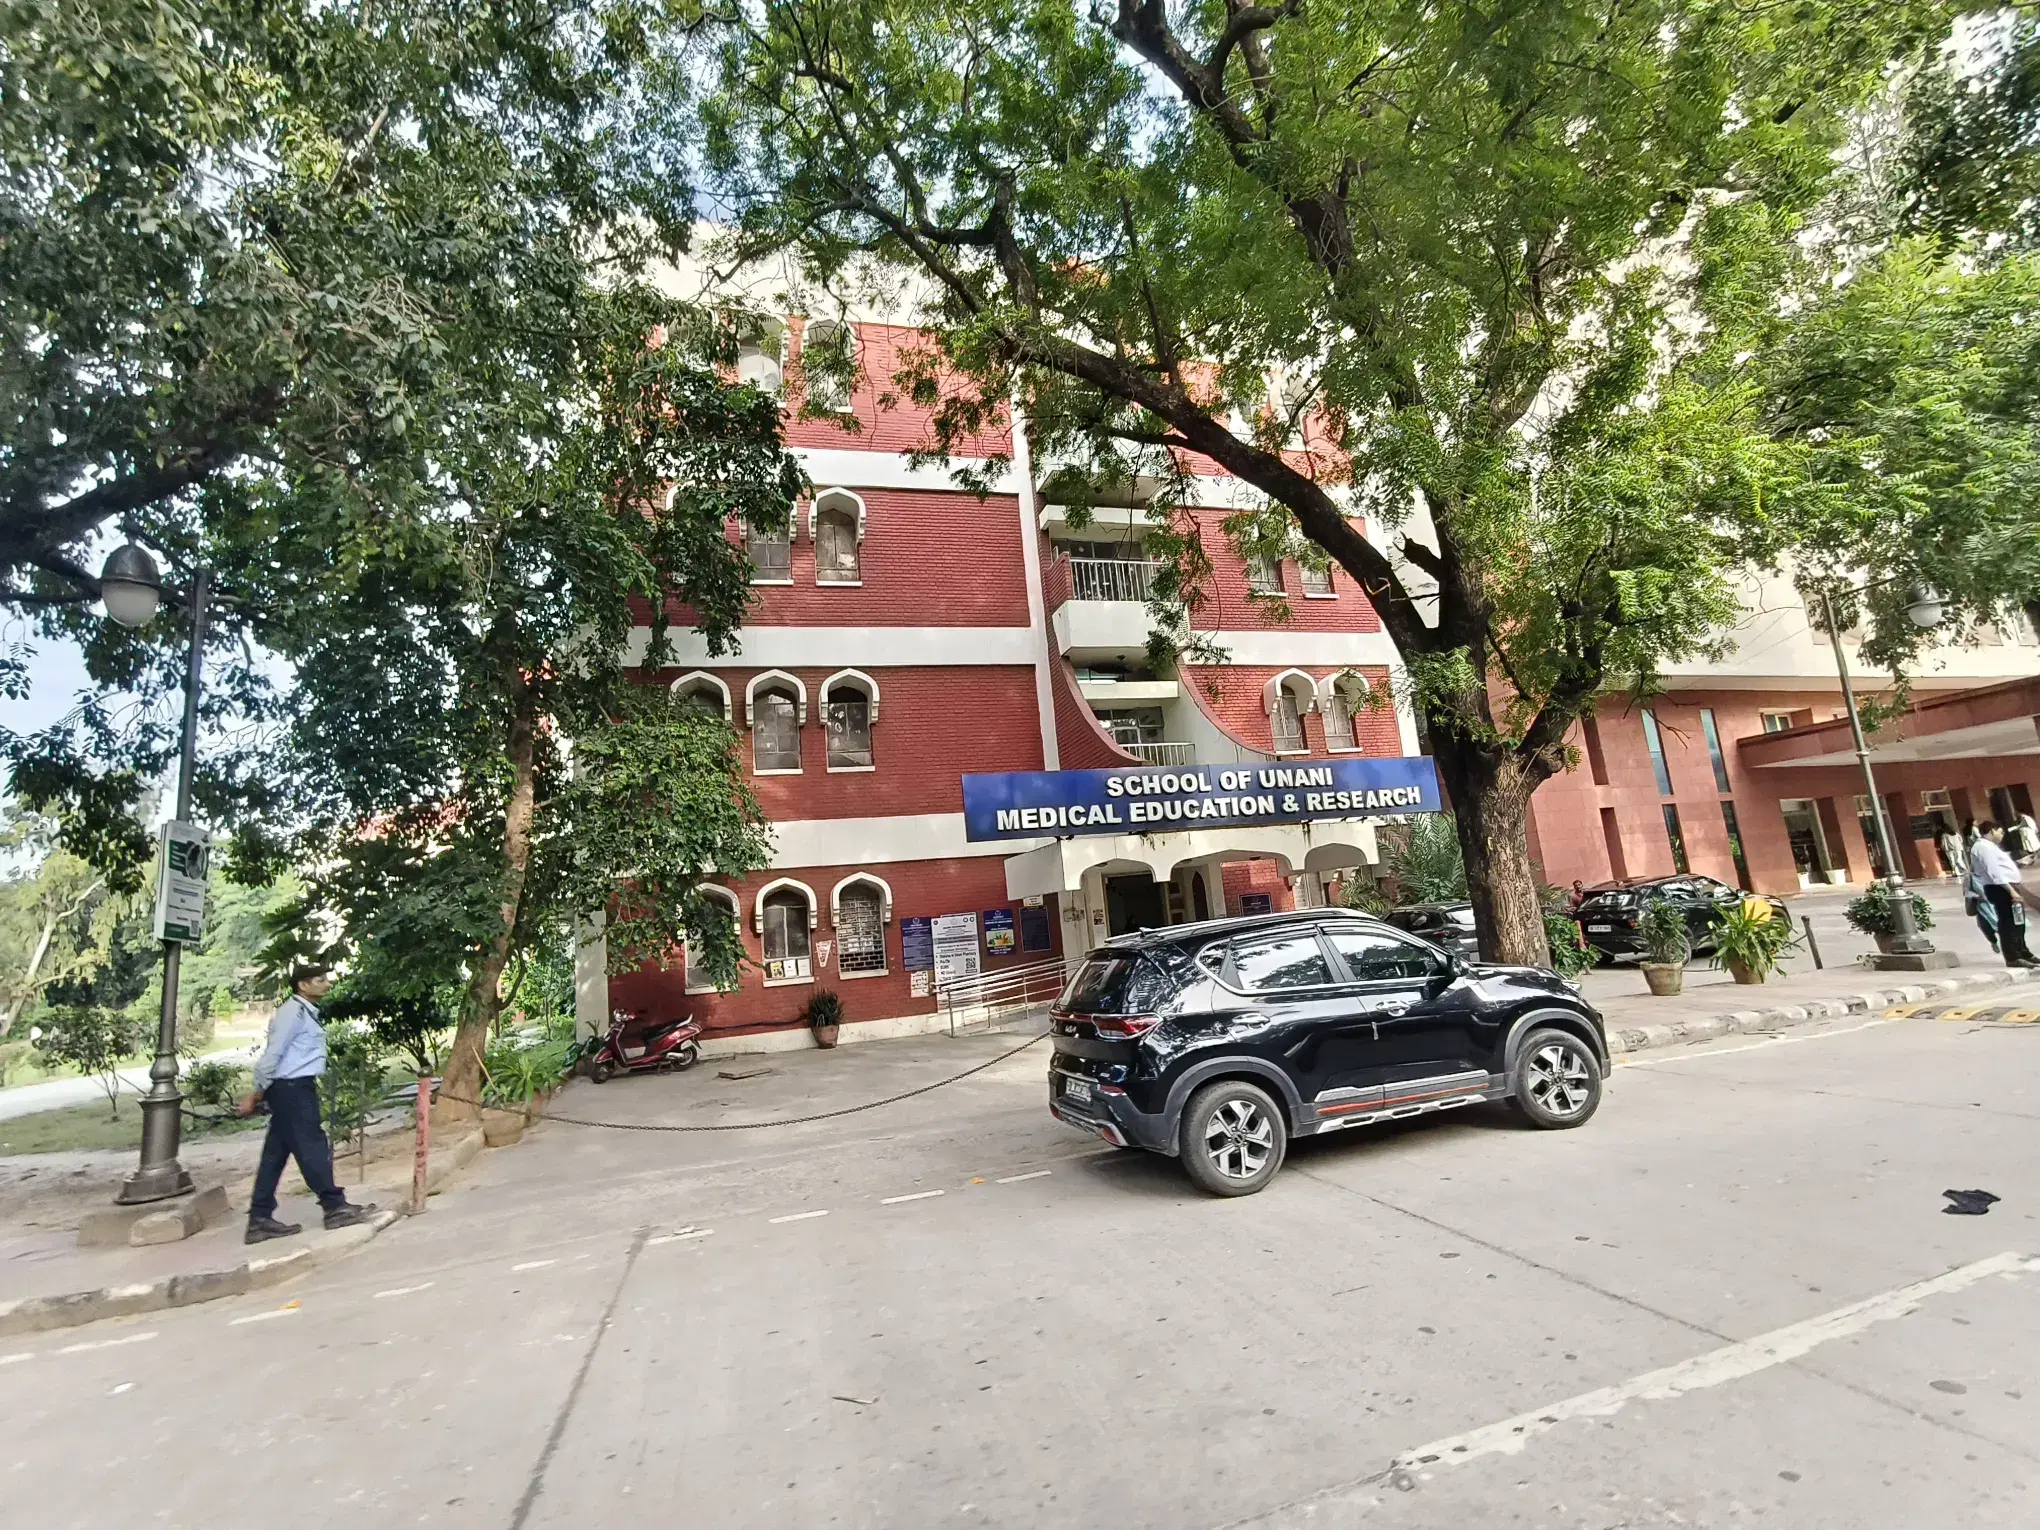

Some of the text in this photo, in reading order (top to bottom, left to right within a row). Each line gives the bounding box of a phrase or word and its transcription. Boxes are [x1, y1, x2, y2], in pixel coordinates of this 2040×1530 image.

[1107, 768, 1333, 797] SCHOOL OF UNANI
[997, 786, 1421, 831] MEDICAL EDUCATION & RESEARCH
